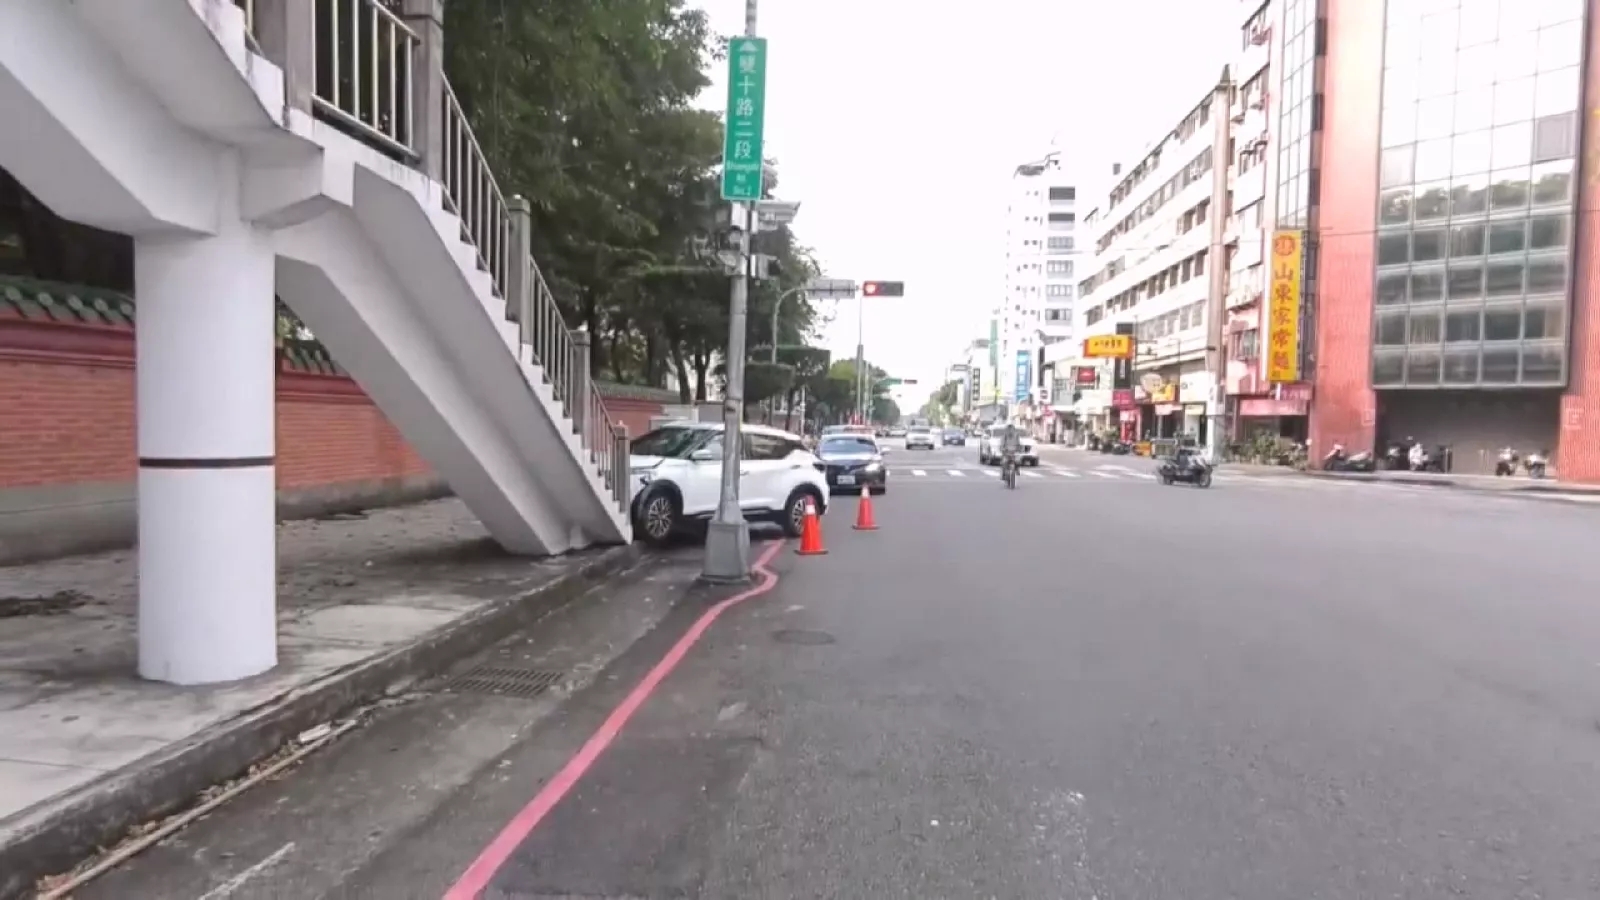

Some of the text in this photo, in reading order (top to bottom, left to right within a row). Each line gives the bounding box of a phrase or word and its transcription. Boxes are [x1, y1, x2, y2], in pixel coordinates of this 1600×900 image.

[734, 54, 756, 159] 雙十路二段
